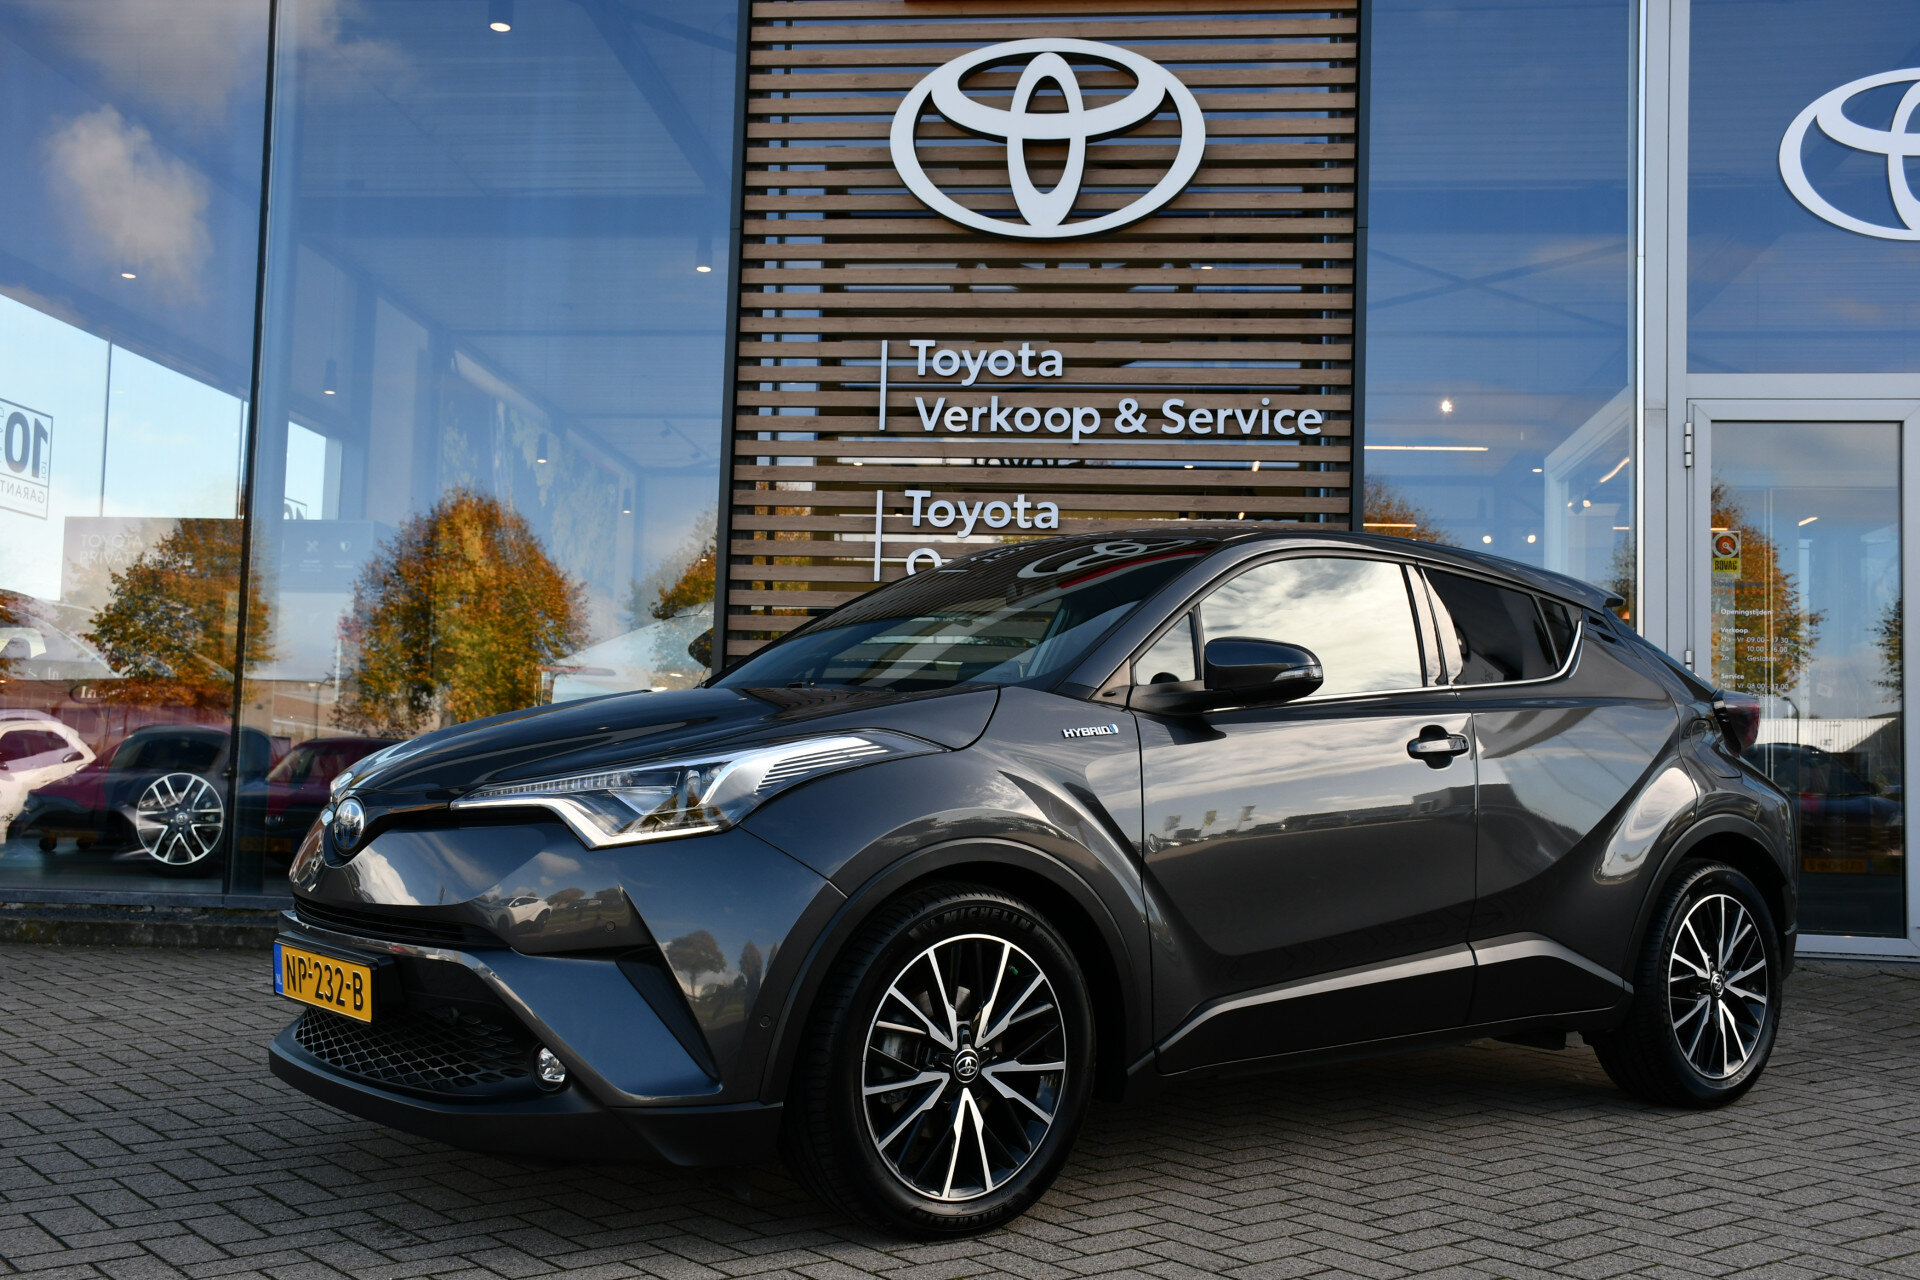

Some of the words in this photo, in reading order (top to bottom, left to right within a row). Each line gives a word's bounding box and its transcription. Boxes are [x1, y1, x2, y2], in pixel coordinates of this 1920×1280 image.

[909, 339, 1064, 386] Toyota
[914, 396, 1101, 444] Verkoop
[1114, 398, 1147, 434] &
[1161, 398, 1324, 436] Service
[905, 489, 1060, 538] Toyota
[80, 534, 143, 548] TOYOTA
[1714, 560, 1737, 571] BOVAG
[1720, 608, 1773, 617] Openingstijden
[1720, 627, 1749, 635] Verkoop
[1062, 725, 1112, 739] HYBRID
[943, 906, 1034, 932] MICHELIN
[285, 953, 364, 1011] NP-232-B
